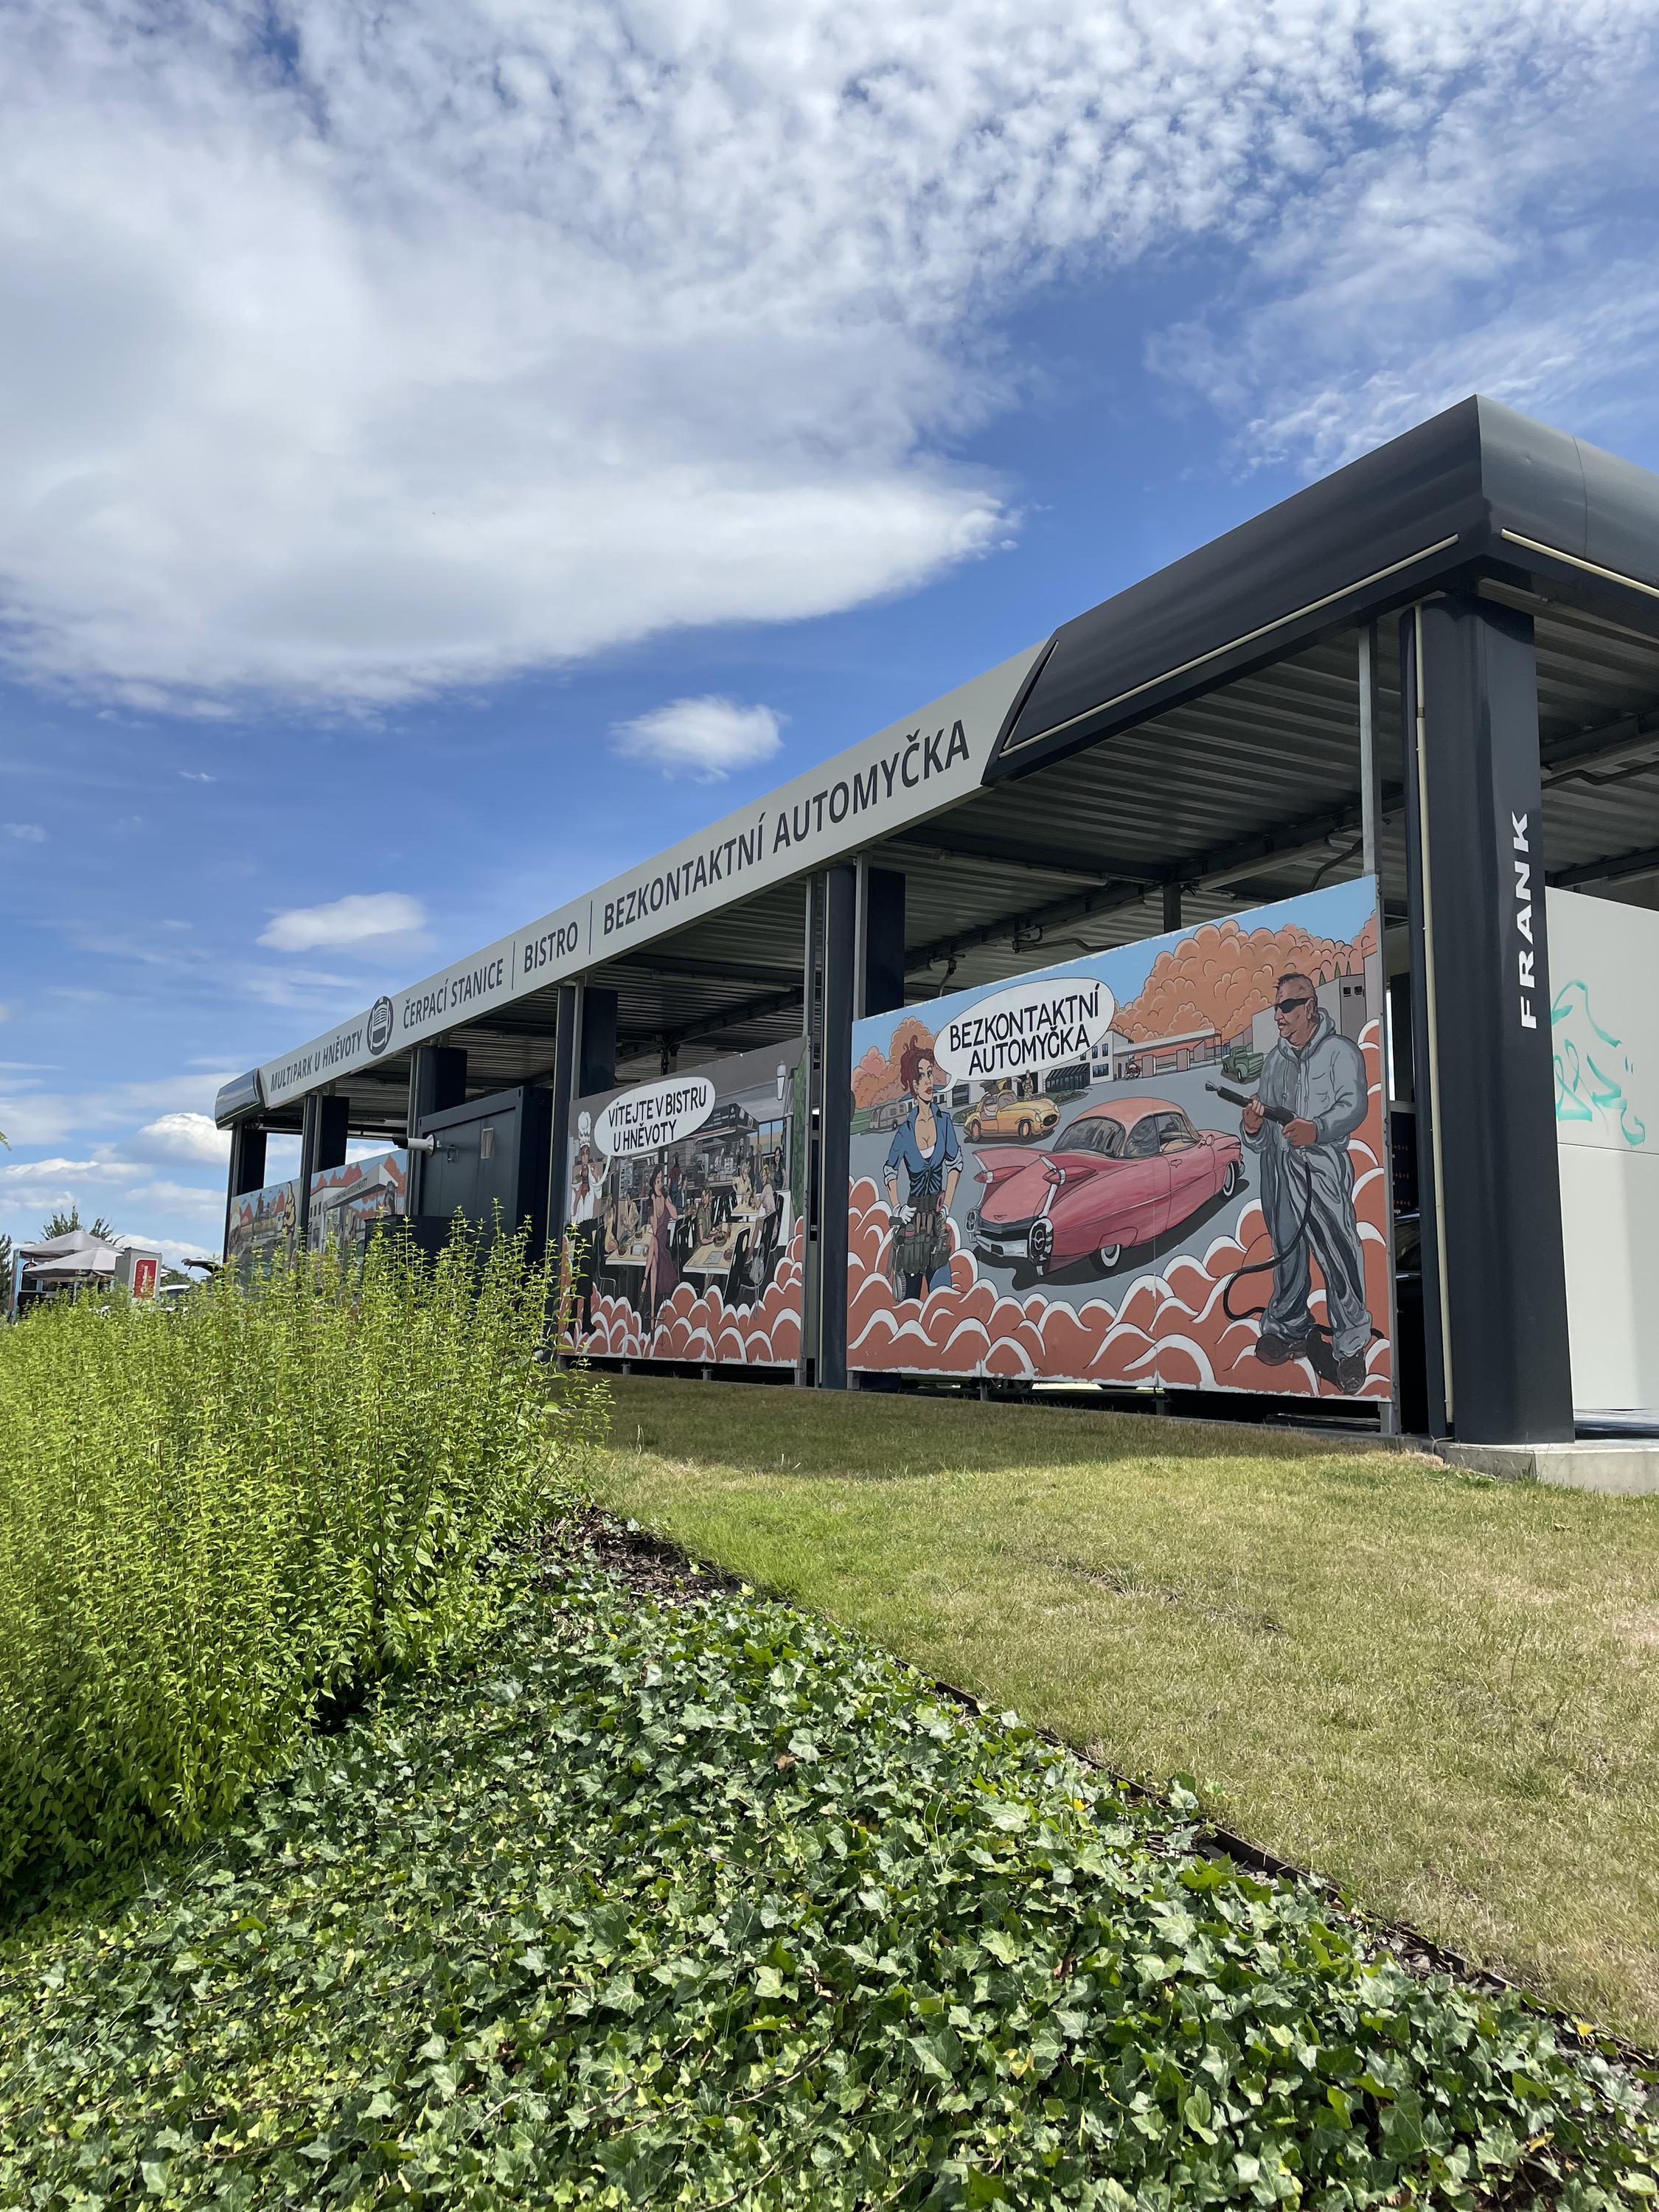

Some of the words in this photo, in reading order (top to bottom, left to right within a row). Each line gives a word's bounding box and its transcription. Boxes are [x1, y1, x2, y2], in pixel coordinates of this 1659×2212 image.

[604, 813, 765, 935] BEZKONTAKTNÍ
[773, 719, 970, 854] AUTOMYČKA
[524, 922, 578, 973] BISTRO
[1512, 811, 1538, 1029] FRANK
[403, 978, 448, 1029] ČERPACÍ
[451, 958, 503, 1007] STANICE
[950, 983, 1100, 1052] BEZKONTAKTNÍ
[271, 1054, 313, 1092] MULTIPARK
[315, 1051, 320, 1072] U
[323, 1029, 363, 1068] HNĚVOTY
[969, 1024, 1091, 1076] AUTOMYČKA
[608, 1099, 653, 1127] VÍTEJTE
[655, 1096, 664, 1117] V
[666, 1085, 706, 1116] BISTRU
[613, 1132, 622, 1152] U
[623, 1119, 677, 1150] HNĚVOTY
